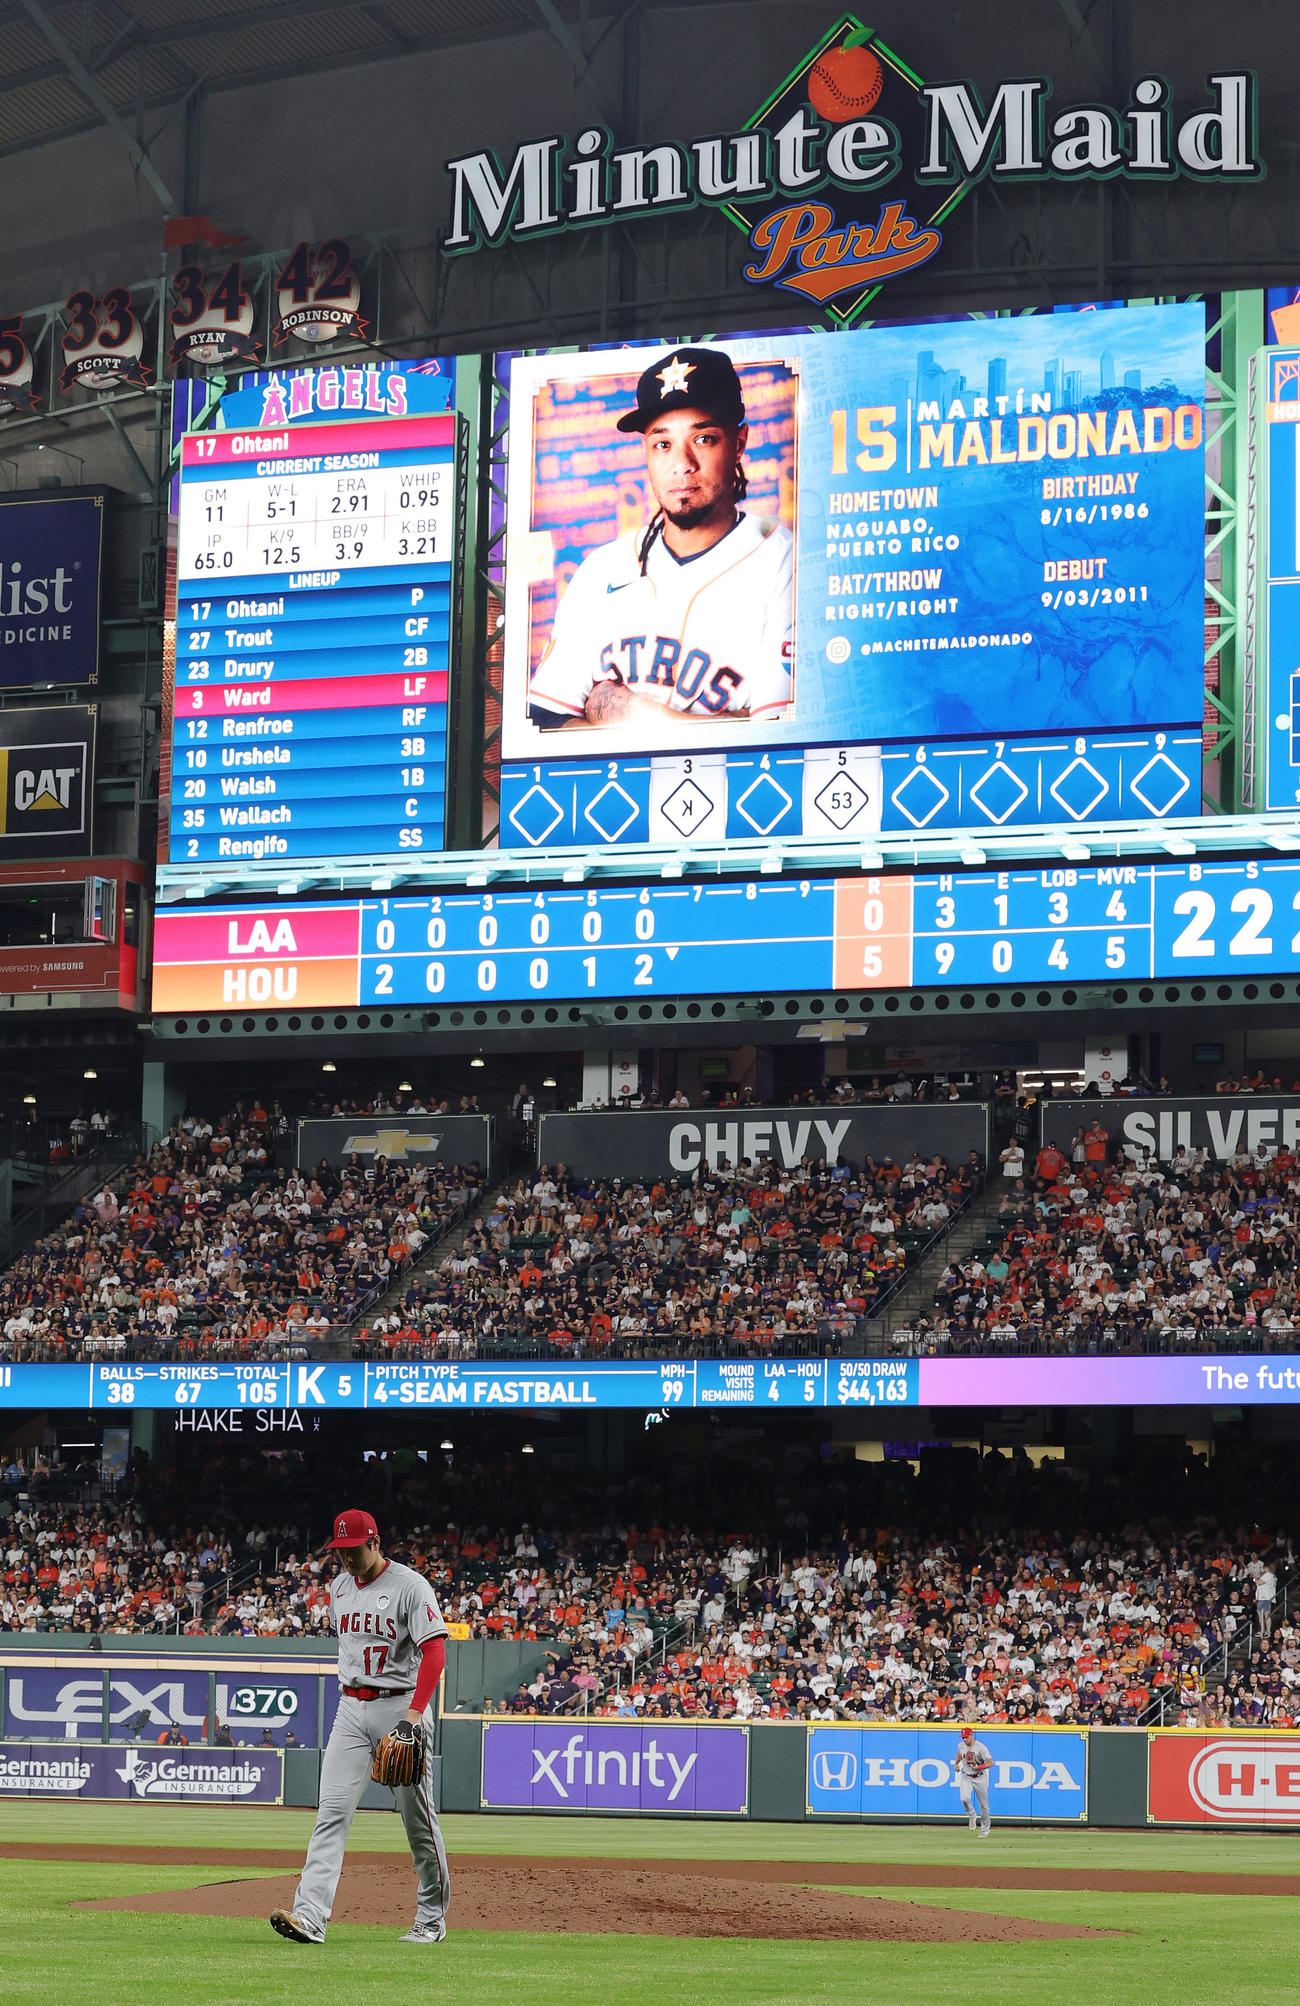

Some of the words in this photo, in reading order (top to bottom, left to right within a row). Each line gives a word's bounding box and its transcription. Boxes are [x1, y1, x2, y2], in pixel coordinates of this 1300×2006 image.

[443, 108, 901, 249] Minute
[920, 74, 1257, 174] Maid
[743, 200, 941, 300] Park
[276, 239, 351, 303] 42
[169, 261, 248, 327] 34
[62, 287, 136, 352] 33
[281, 308, 354, 330] ROBINSON
[189, 331, 226, 345] RYAN
[77, 358, 121, 373] SCOTT
[260, 370, 408, 426] ANGELS
[917, 388, 1051, 421] MARTÍN
[196, 439, 216, 457] 17
[231, 433, 289, 455] Ohtani
[829, 405, 897, 475] 15
[918, 404, 1202, 469] MALDONADO
[256, 457, 322, 476] CURRENT
[323, 453, 380, 472] SEASON
[204, 488, 227, 502] GM
[268, 483, 298, 497] W-L
[337, 478, 367, 493] ERA
[400, 471, 441, 487] WHIP
[1042, 472, 1139, 500] BIRTHDAY
[205, 506, 224, 522] 11
[267, 500, 297, 518] 5-1
[331, 495, 369, 514] 2.91
[400, 490, 439, 508] 0.95
[829, 486, 938, 515] HOMETOWN
[1040, 503, 1149, 526] 8/16/1986
[208, 535, 221, 547] IP
[270, 529, 295, 543] K/9
[333, 524, 368, 539] BB/9
[827, 518, 935, 539] NAGUABO,
[195, 551, 233, 570] 65.0
[263, 546, 300, 565] 12.5
[335, 542, 364, 560] 3.9
[398, 537, 437, 556] 3.21
[826, 538, 901, 558] PUERTO
[912, 534, 960, 554] RICO
[289, 571, 341, 589] LINEUP
[828, 568, 942, 596] BAT/THROW
[1043, 558, 1107, 582] DEBUT
[191, 602, 211, 621] 17
[226, 598, 284, 618] Ohtani
[411, 588, 424, 606] P
[825, 598, 959, 621] RIGHT/RIGHT
[1041, 586, 1148, 609] 9/03/2011
[0, 625, 72, 644] DICINE
[189, 631, 211, 650] 27
[225, 629, 273, 648] Trout
[405, 617, 429, 637] CF
[861, 632, 1033, 655] @MACHETEMALDONADO
[188, 661, 210, 680] 23
[224, 659, 274, 680] Drury
[403, 647, 428, 667] 2B
[192, 691, 203, 709] 3
[223, 686, 271, 707] Ward
[404, 678, 426, 696] LF
[186, 720, 208, 739] 12
[222, 718, 293, 737] Renfroe
[402, 707, 427, 727] RF
[185, 750, 207, 768] 10
[221, 745, 291, 767] Urshela
[400, 738, 425, 757] 3B
[15, 768, 75, 811] CAT
[184, 779, 206, 798] 20
[220, 776, 276, 796] Walsh
[401, 768, 425, 787] 1B
[183, 809, 205, 828] 35
[219, 805, 291, 826] Wallach
[405, 798, 418, 817] C
[187, 839, 199, 857] 2
[219, 835, 288, 859] Rengifo
[399, 828, 423, 847] SS
[869, 879, 880, 895] R
[939, 874, 952, 892] H
[997, 872, 1009, 890] E
[1041, 869, 1078, 888] LOB
[1097, 867, 1137, 885] MVR
[1189, 864, 1202, 881] B
[1246, 861, 1259, 879] S
[228, 918, 297, 954] LAA
[376, 919, 395, 950] 0
[427, 917, 446, 949] 0
[479, 915, 498, 947] 0
[530, 912, 550, 944] 0
[583, 910, 602, 943] 0
[635, 908, 654, 940] 0
[863, 899, 883, 931] 0
[935, 896, 955, 929] 3
[994, 894, 1008, 926] 1
[1048, 892, 1068, 924] 3
[1106, 889, 1127, 921] 4
[1172, 890, 1216, 958] 2
[1229, 888, 1273, 956] 2
[30, 964, 40, 974] by
[43, 962, 84, 971] SAMSUNG
[223, 967, 297, 1002] HOU
[375, 963, 394, 995] 2
[426, 961, 445, 993] 0
[477, 959, 497, 992] 0
[529, 957, 549, 989] 0
[582, 956, 596, 987] 1
[634, 953, 653, 985] 2
[863, 945, 882, 977] 5
[935, 942, 955, 975] 9
[992, 940, 1013, 973] 0
[1048, 938, 1068, 970] 4
[1105, 936, 1126, 968] 5
[669, 1119, 852, 1172] CHEVY
[100, 1367, 143, 1380] BALLS
[160, 1367, 218, 1380] STRIKES
[235, 1366, 280, 1380] TOTAL
[376, 1367, 418, 1379] PITCH
[423, 1366, 458, 1379] TYPE
[661, 1365, 685, 1378] MPH
[719, 1365, 754, 1376] MOUND
[726, 1378, 754, 1388] VISITS
[764, 1364, 785, 1377] LAA
[798, 1364, 821, 1377] HOU
[840, 1363, 870, 1376] 50/50
[873, 1363, 907, 1376] DRAW
[1202, 1366, 1248, 1389] The
[107, 1383, 134, 1403] 38
[175, 1383, 201, 1403] 67
[237, 1382, 277, 1403] 105
[297, 1366, 326, 1404] K
[338, 1376, 351, 1396] 5
[374, 1382, 468, 1403] 4-SEAM
[474, 1381, 597, 1402] FASTBALL
[662, 1381, 683, 1401] 99
[702, 1390, 754, 1401] REMAINING
[768, 1380, 778, 1401] 4
[804, 1380, 814, 1401] 5
[838, 1378, 907, 1405] $44,163
[255, 1409, 320, 1431] SHA
[340, 1612, 397, 1640] NGELS
[363, 1646, 389, 1675] 17
[236, 1688, 298, 1715] 370
[158, 1758, 261, 1783] Germania
[530, 1735, 698, 1800] xfinity
[165, 1783, 242, 1793] INSURANCE
